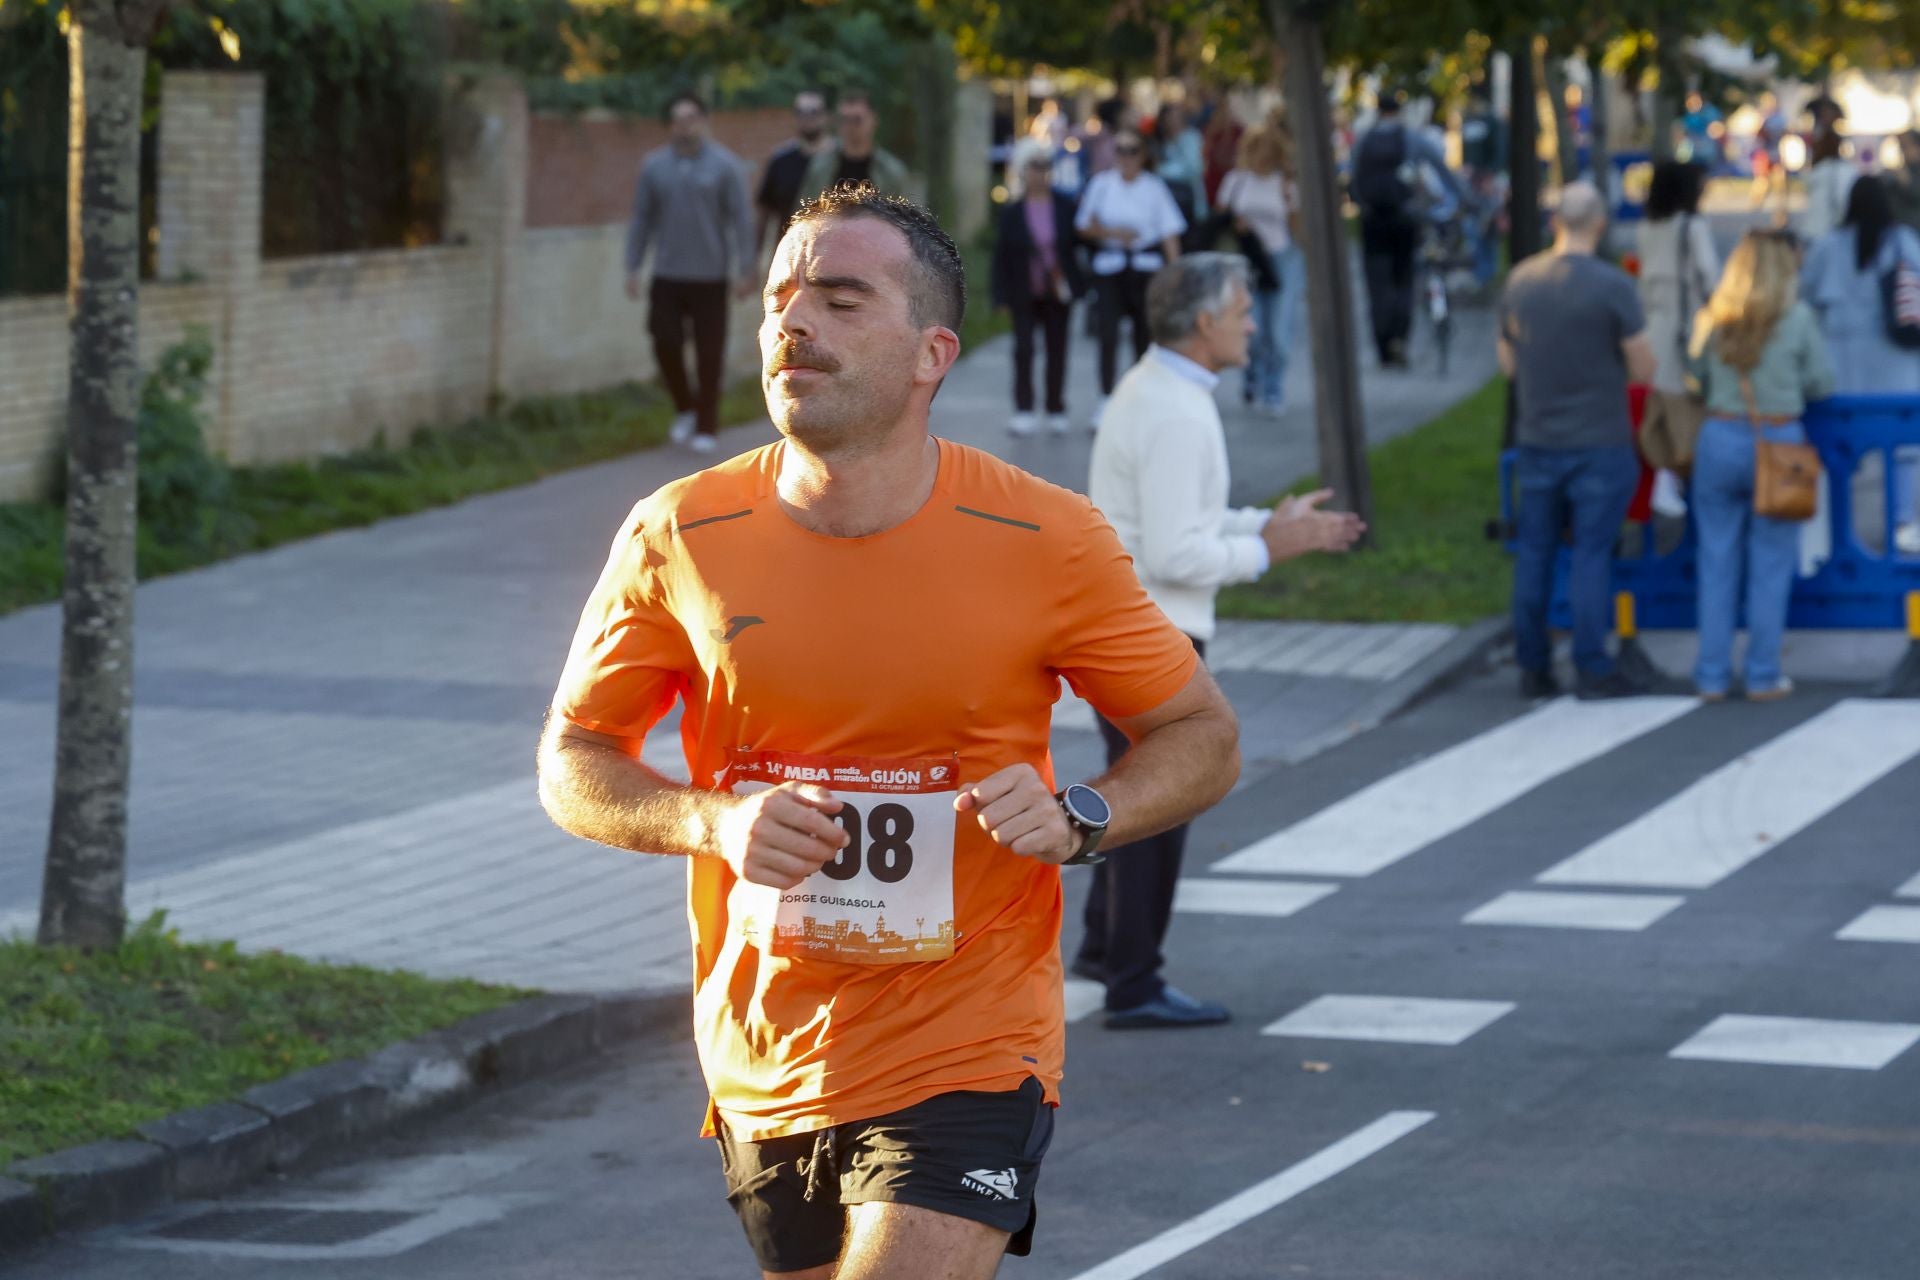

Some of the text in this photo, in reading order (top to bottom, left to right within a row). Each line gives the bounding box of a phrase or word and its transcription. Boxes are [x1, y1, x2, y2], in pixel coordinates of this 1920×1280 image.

[784, 766, 831, 780] MBA
[833, 766, 860, 775] media
[871, 768, 920, 785] GIJÓN
[833, 774, 869, 783] maratón
[779, 894, 886, 909] JORGE GUISASOLA
[961, 1177, 994, 1197] NIKE
